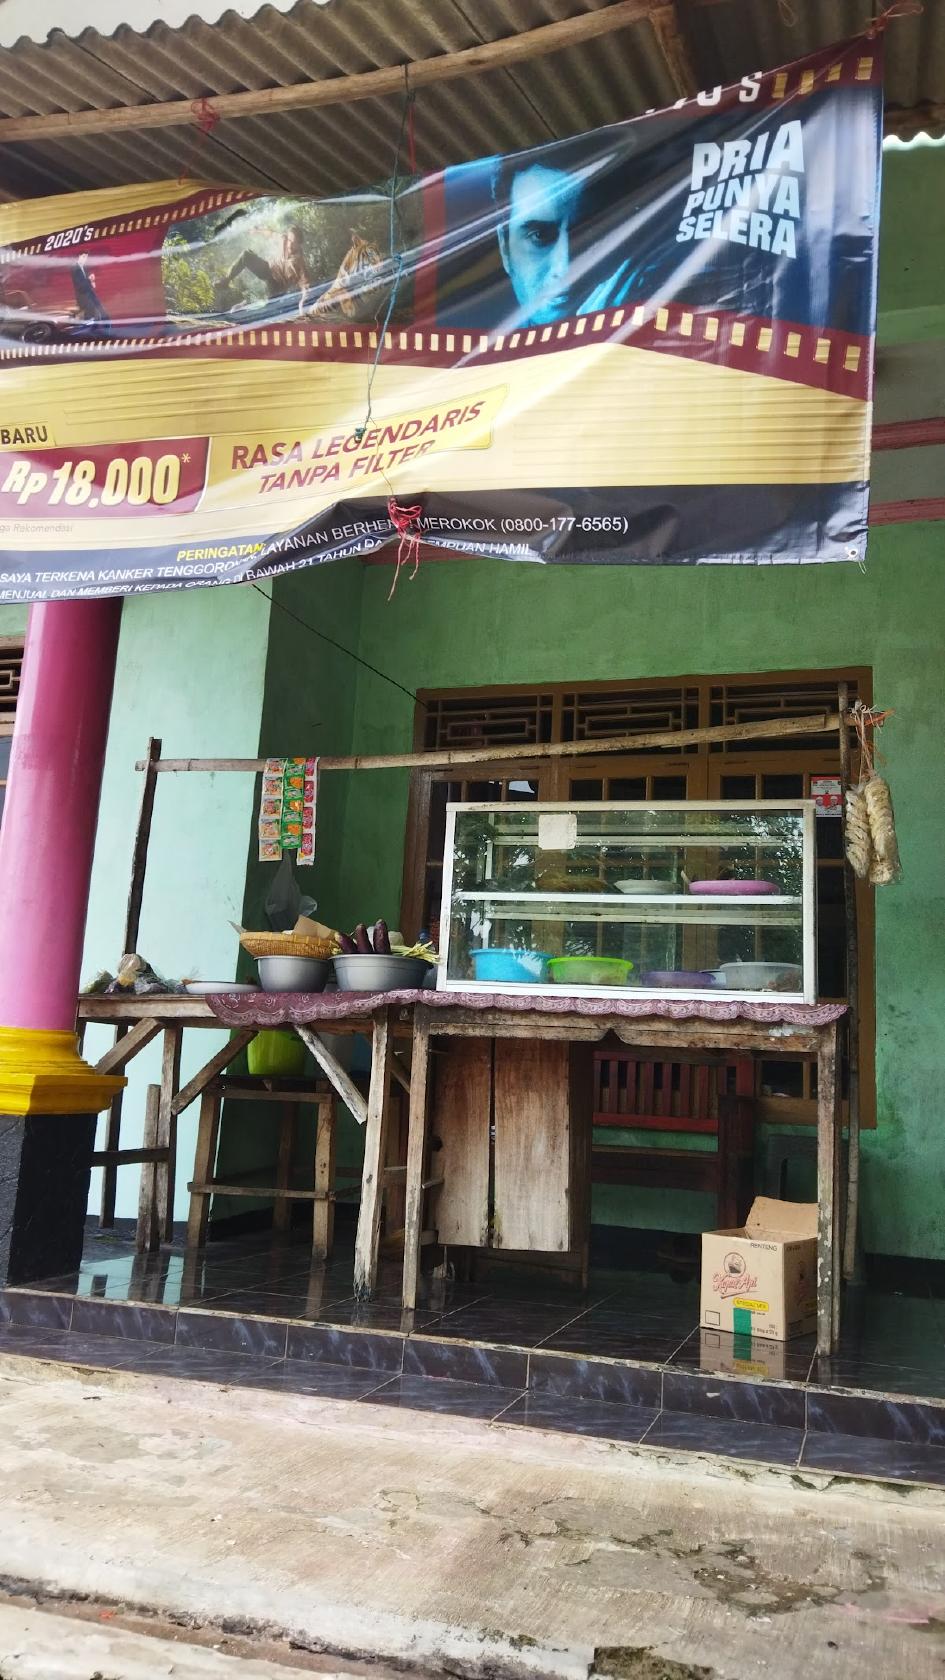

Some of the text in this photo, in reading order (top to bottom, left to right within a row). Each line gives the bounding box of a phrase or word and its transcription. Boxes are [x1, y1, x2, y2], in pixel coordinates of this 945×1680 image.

[690, 120, 804, 191] PRIA
[683, 173, 800, 218] PUNYA
[44, 225, 94, 251] 2020's
[676, 209, 796, 258] SELERA
[0, 425, 48, 444] BARU
[231, 401, 486, 470] RASA LEGENDARIS
[1, 461, 48, 505] Rp
[258, 439, 436, 494] TANPA FILTER
[0, 572, 31, 583] SAYA
[35, 571, 95, 582] TERKENA
[98, 568, 153, 581] KANKER
[261, 531, 328, 556] LAYANAN
[417, 517, 497, 531] MEROKOK
[501, 516, 629, 534] (0800-177-6565)
[78, 584, 133, 596] MEMBERI
[319, 543, 360, 562] TAHUN
[489, 543, 531, 555] HAMIL
